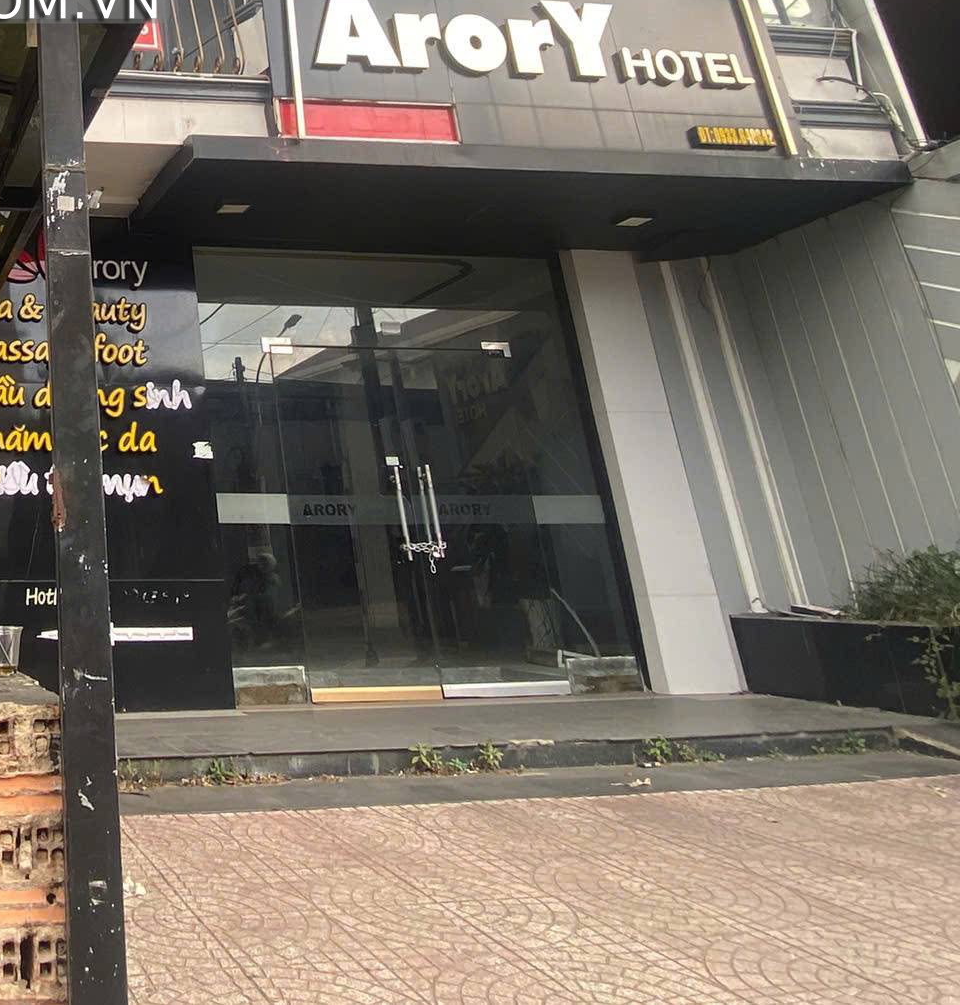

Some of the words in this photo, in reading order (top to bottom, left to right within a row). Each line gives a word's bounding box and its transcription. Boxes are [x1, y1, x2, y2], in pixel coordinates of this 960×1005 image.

[622, 46, 756, 86] HOTEL
[92, 259, 149, 287] rory
[93, 298, 148, 332] auty
[95, 332, 148, 366] foot
[118, 421, 158, 453] da
[303, 503, 356, 517] ARORY
